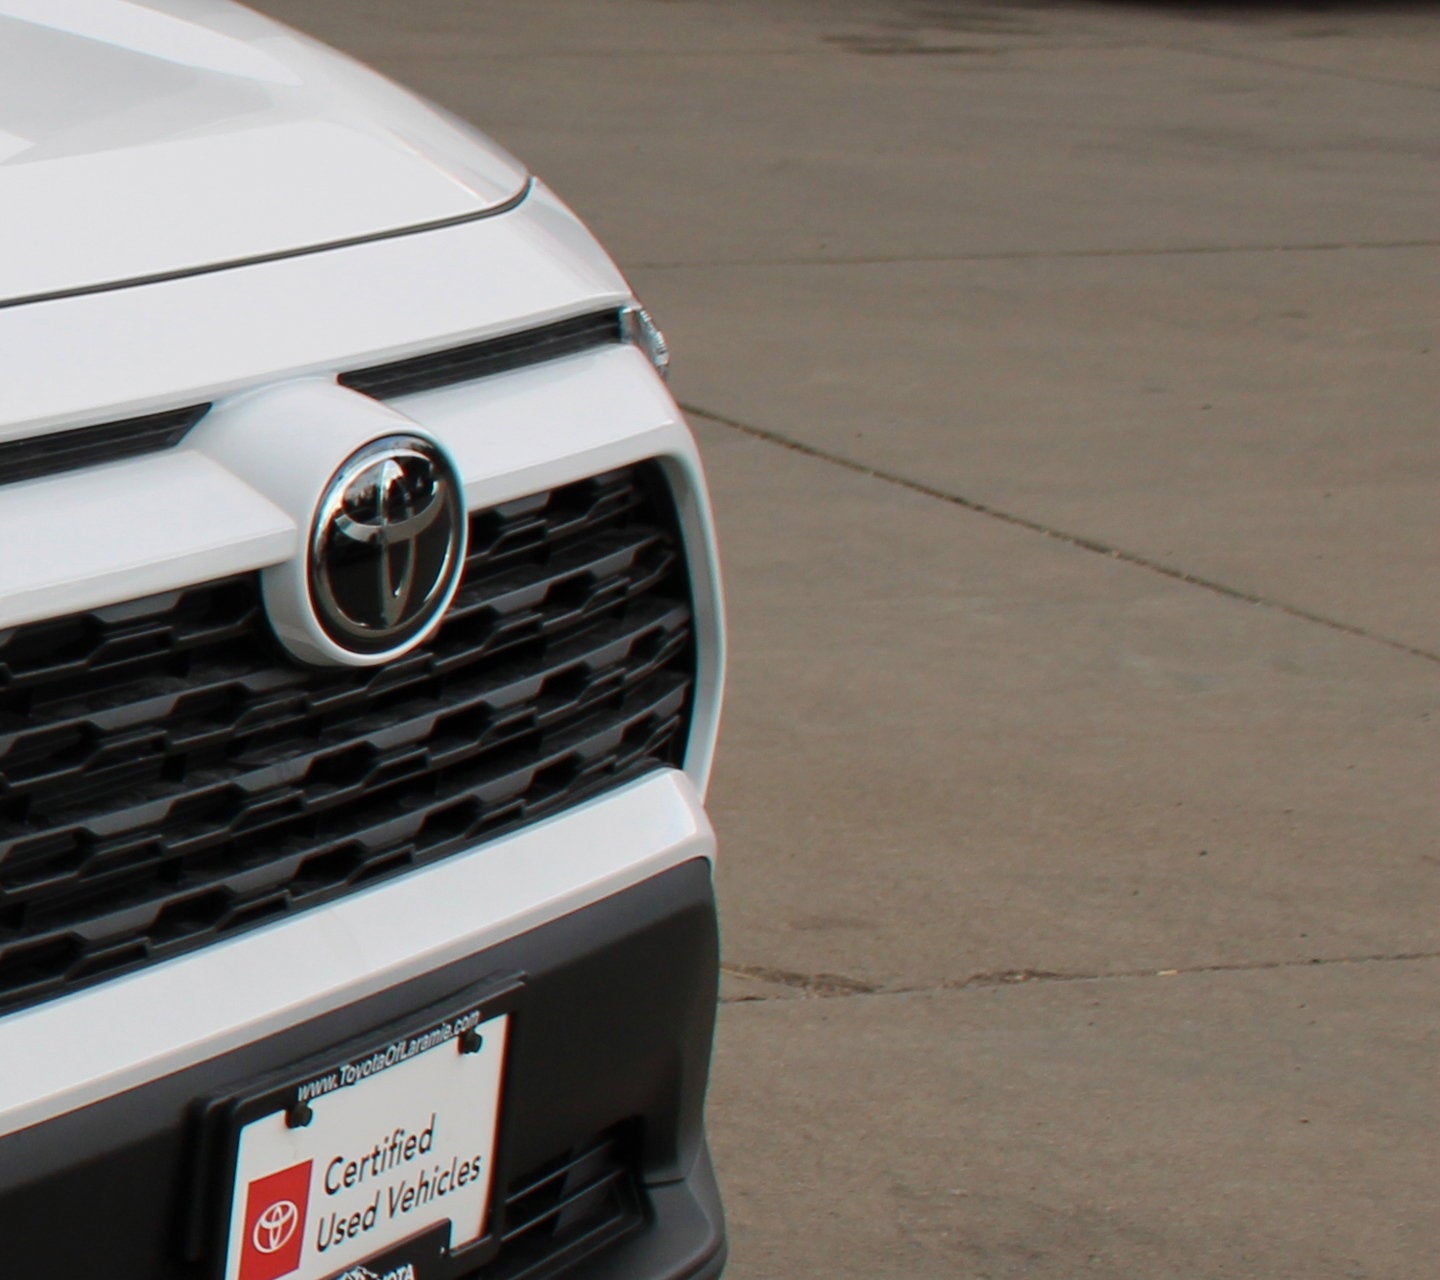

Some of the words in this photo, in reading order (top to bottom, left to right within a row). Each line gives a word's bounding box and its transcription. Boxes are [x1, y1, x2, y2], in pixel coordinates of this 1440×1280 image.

[324, 1112, 437, 1196] Certified
[316, 1189, 381, 1253] Used
[388, 1154, 482, 1219] Vehicles
